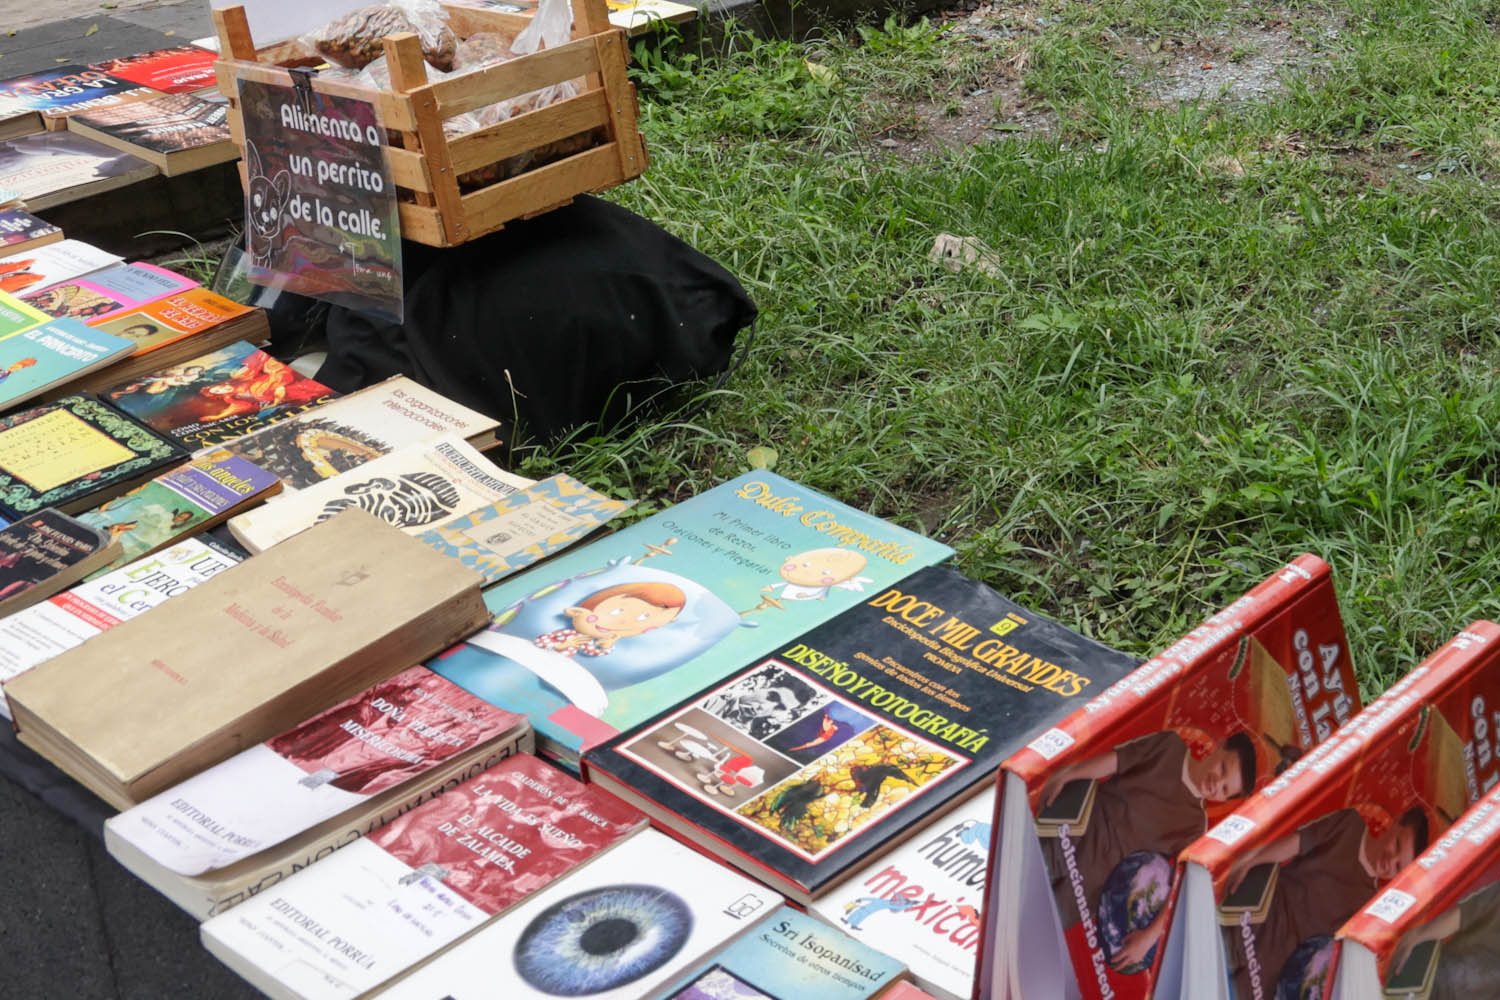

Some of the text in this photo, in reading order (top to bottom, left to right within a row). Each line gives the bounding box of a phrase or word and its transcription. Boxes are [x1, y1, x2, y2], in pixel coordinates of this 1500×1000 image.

[280, 102, 380, 147] Alimenta a
[289, 154, 384, 193] un perrito
[289, 195, 387, 241] de la calle.
[23, 327, 41, 341] EL
[40, 333, 99, 363] PRINCIPITO
[183, 414, 260, 444] CON LOS
[211, 465, 257, 496] ángeles
[707, 526, 758, 554] de Rezos
[712, 510, 793, 551] Mi Primer libro
[735, 481, 916, 566] Dulce Compañía
[661, 520, 774, 577] Oraciones y Plegarias
[100, 583, 125, 597] el
[868, 588, 1092, 698] DOCE MIL GRANDES
[997, 620, 1012, 633] 9
[880, 615, 1037, 694] Enciclopedia Biográfica Universal
[881, 655, 963, 699] Encuentros con los
[781, 643, 855, 692] DISEÑO
[862, 683, 991, 754] FOTOGRAFÍA
[852, 650, 972, 714] genios de todos los tiempos
[1292, 629, 1334, 743] con la
[369, 697, 409, 723] DOÑA
[1470, 695, 1492, 769] con
[170, 798, 226, 840] EDITORIAL
[472, 784, 495, 801] LA
[493, 797, 526, 820] VIDA
[437, 821, 517, 873] DE ZALAMEA
[457, 813, 533, 860] EL ALCALDE
[917, 822, 988, 892] humo
[1057, 822, 1099, 950] Solucionario
[269, 897, 332, 940] EDITORIAL
[326, 935, 377, 971] PORRÚA
[772, 918, 798, 942] Sri
[759, 932, 868, 993] Secretos de otros tiempos
